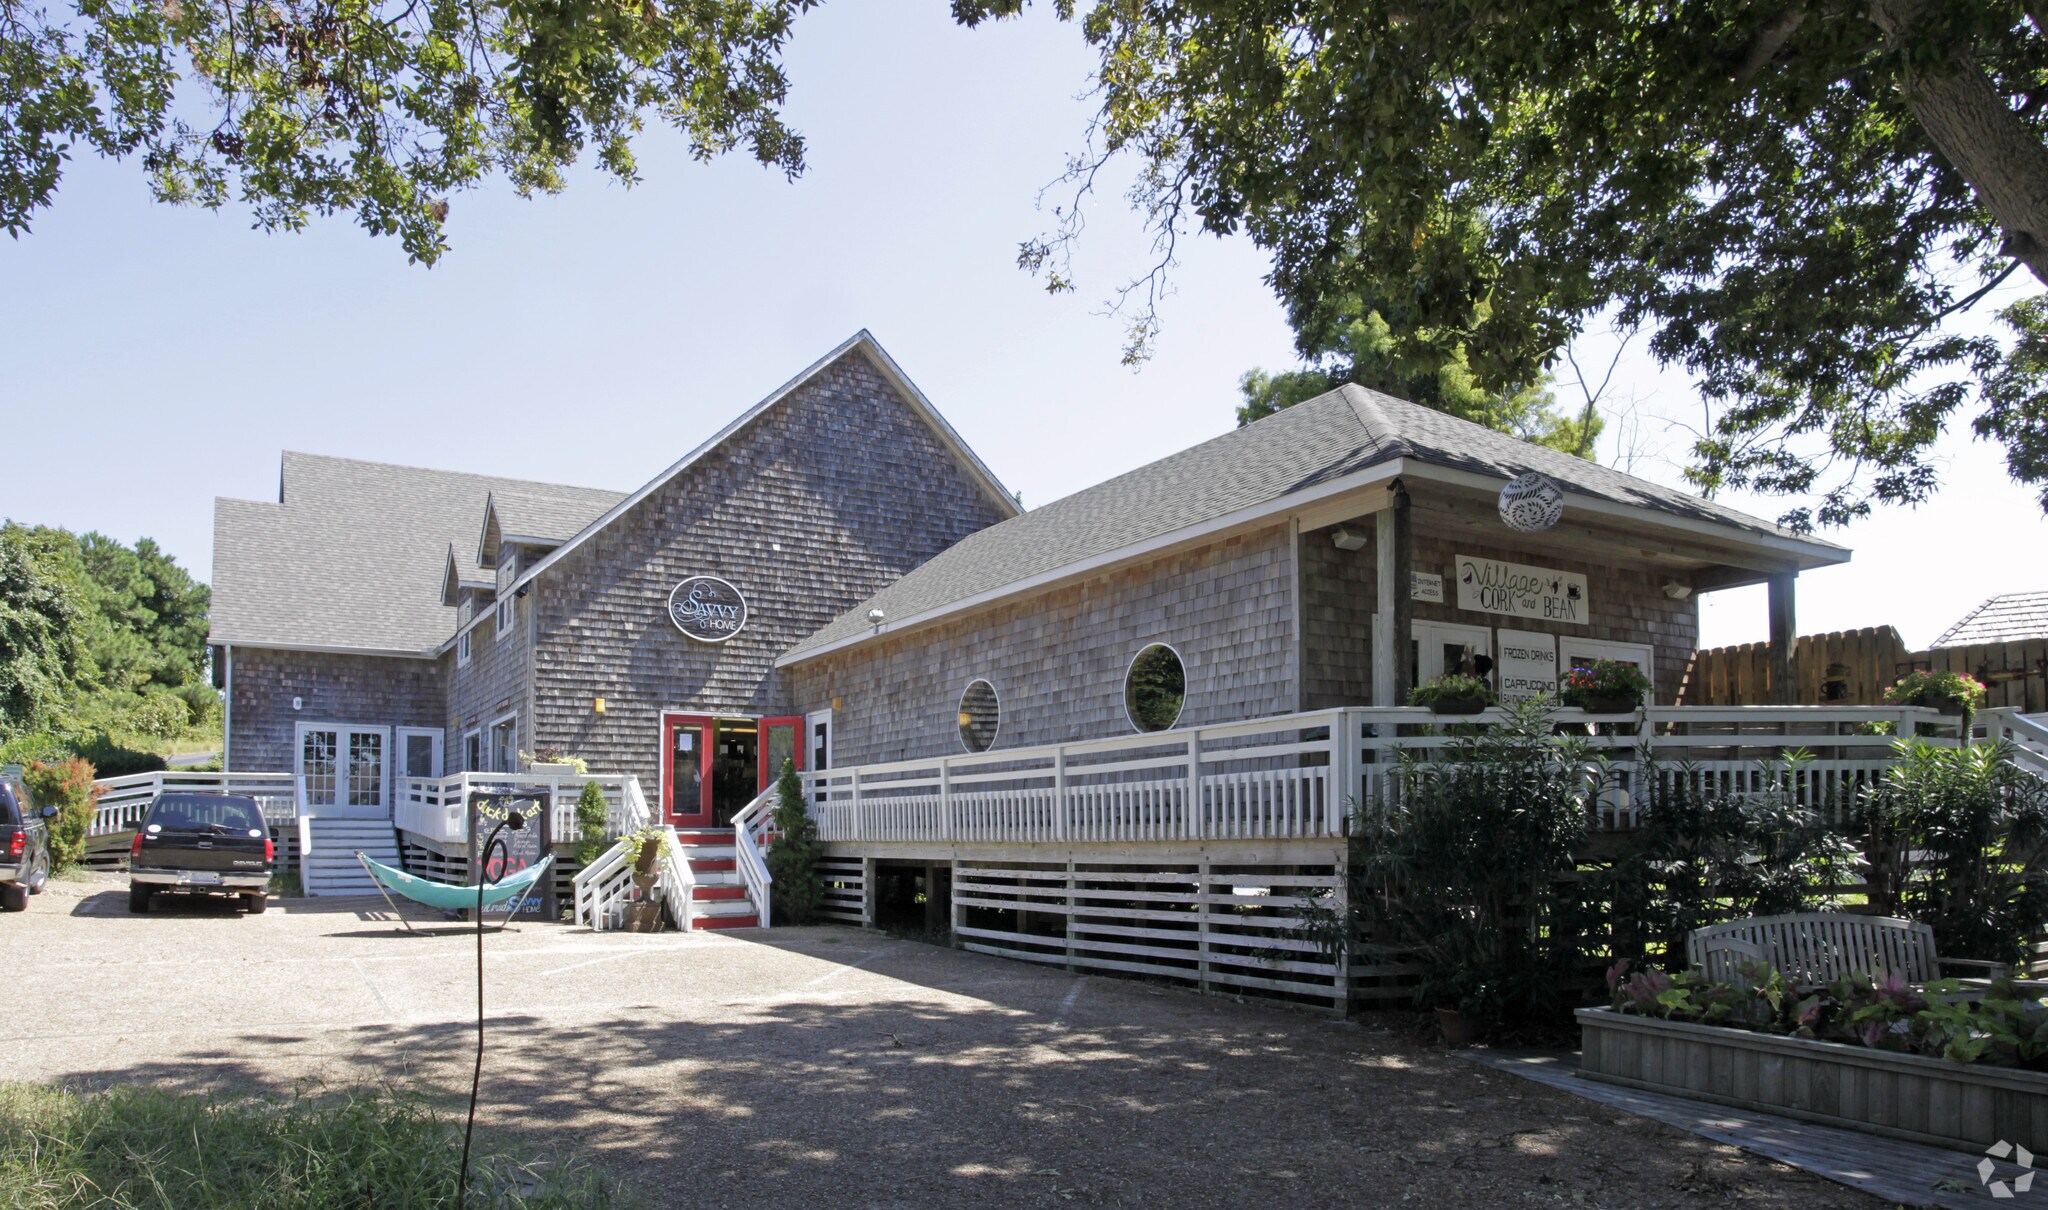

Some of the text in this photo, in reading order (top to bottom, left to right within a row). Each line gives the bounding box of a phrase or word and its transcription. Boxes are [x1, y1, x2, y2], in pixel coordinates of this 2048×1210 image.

[1462, 562, 1544, 598] Village
[1480, 586, 1577, 620] CORK and BEAN
[709, 620, 736, 630] HOME
[1504, 648, 1554, 662] FROZEN DRINKS
[1504, 678, 1555, 691] CAPPUCCINO
